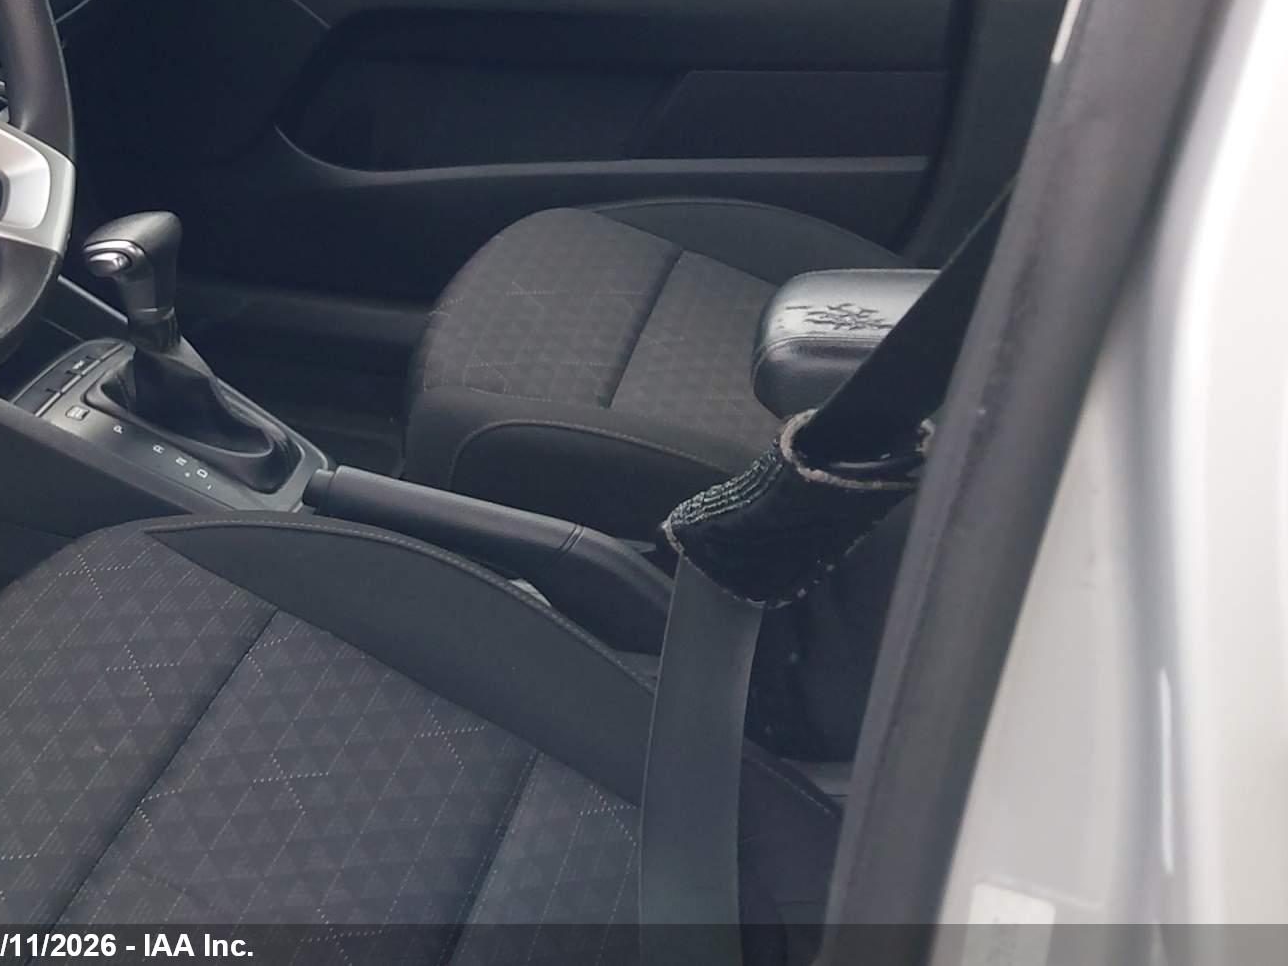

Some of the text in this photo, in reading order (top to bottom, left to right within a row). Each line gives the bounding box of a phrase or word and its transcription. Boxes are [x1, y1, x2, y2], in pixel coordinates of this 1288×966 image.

[113, 424, 123, 434] P
[153, 444, 165, 454] R
[196, 468, 209, 479] D
